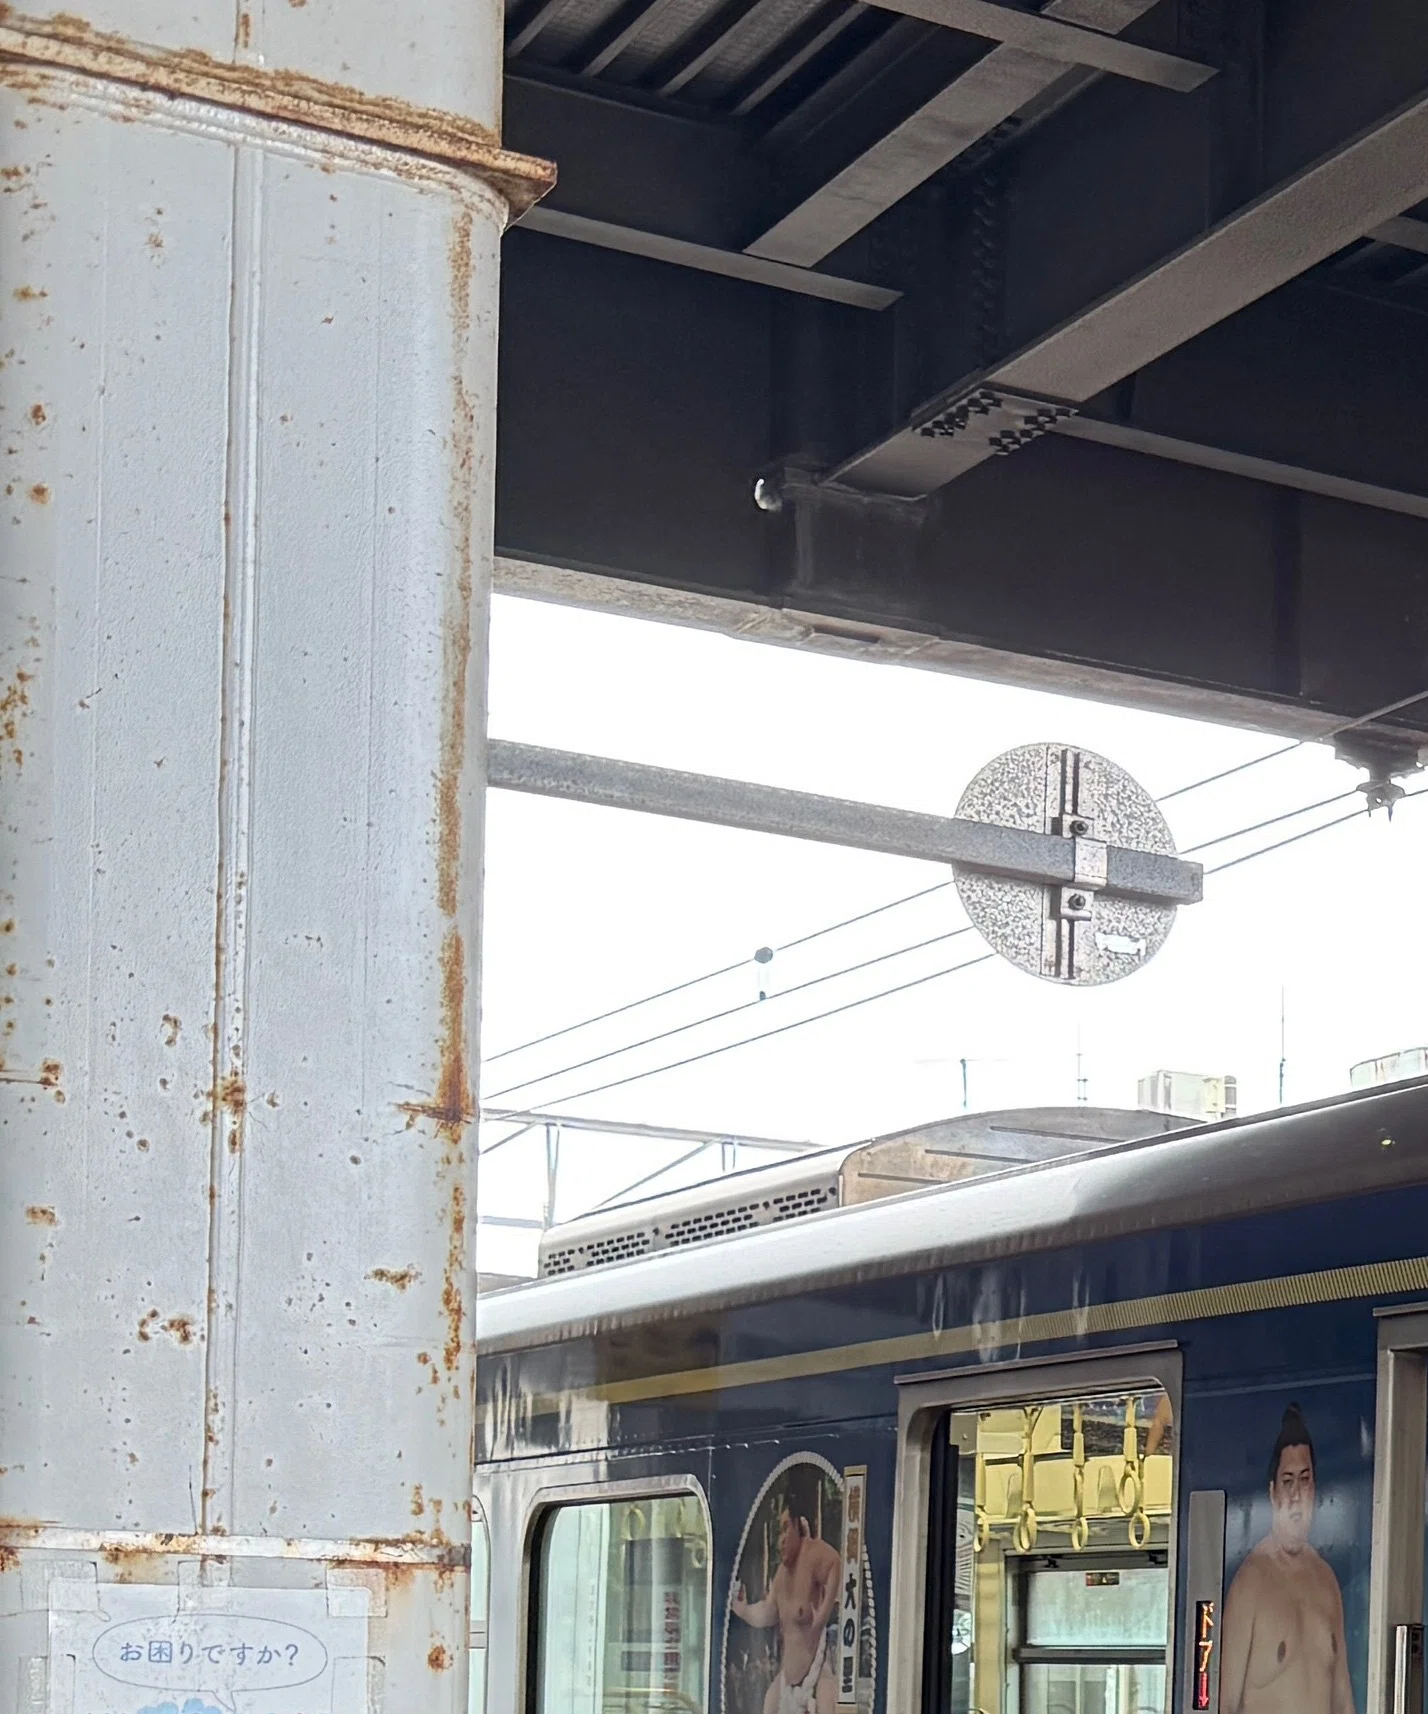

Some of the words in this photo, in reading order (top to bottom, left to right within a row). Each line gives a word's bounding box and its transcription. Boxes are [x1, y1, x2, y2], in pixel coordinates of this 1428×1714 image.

[120, 1640, 299, 1666] お困りですか?
[1198, 1602, 1215, 1671] ドア
